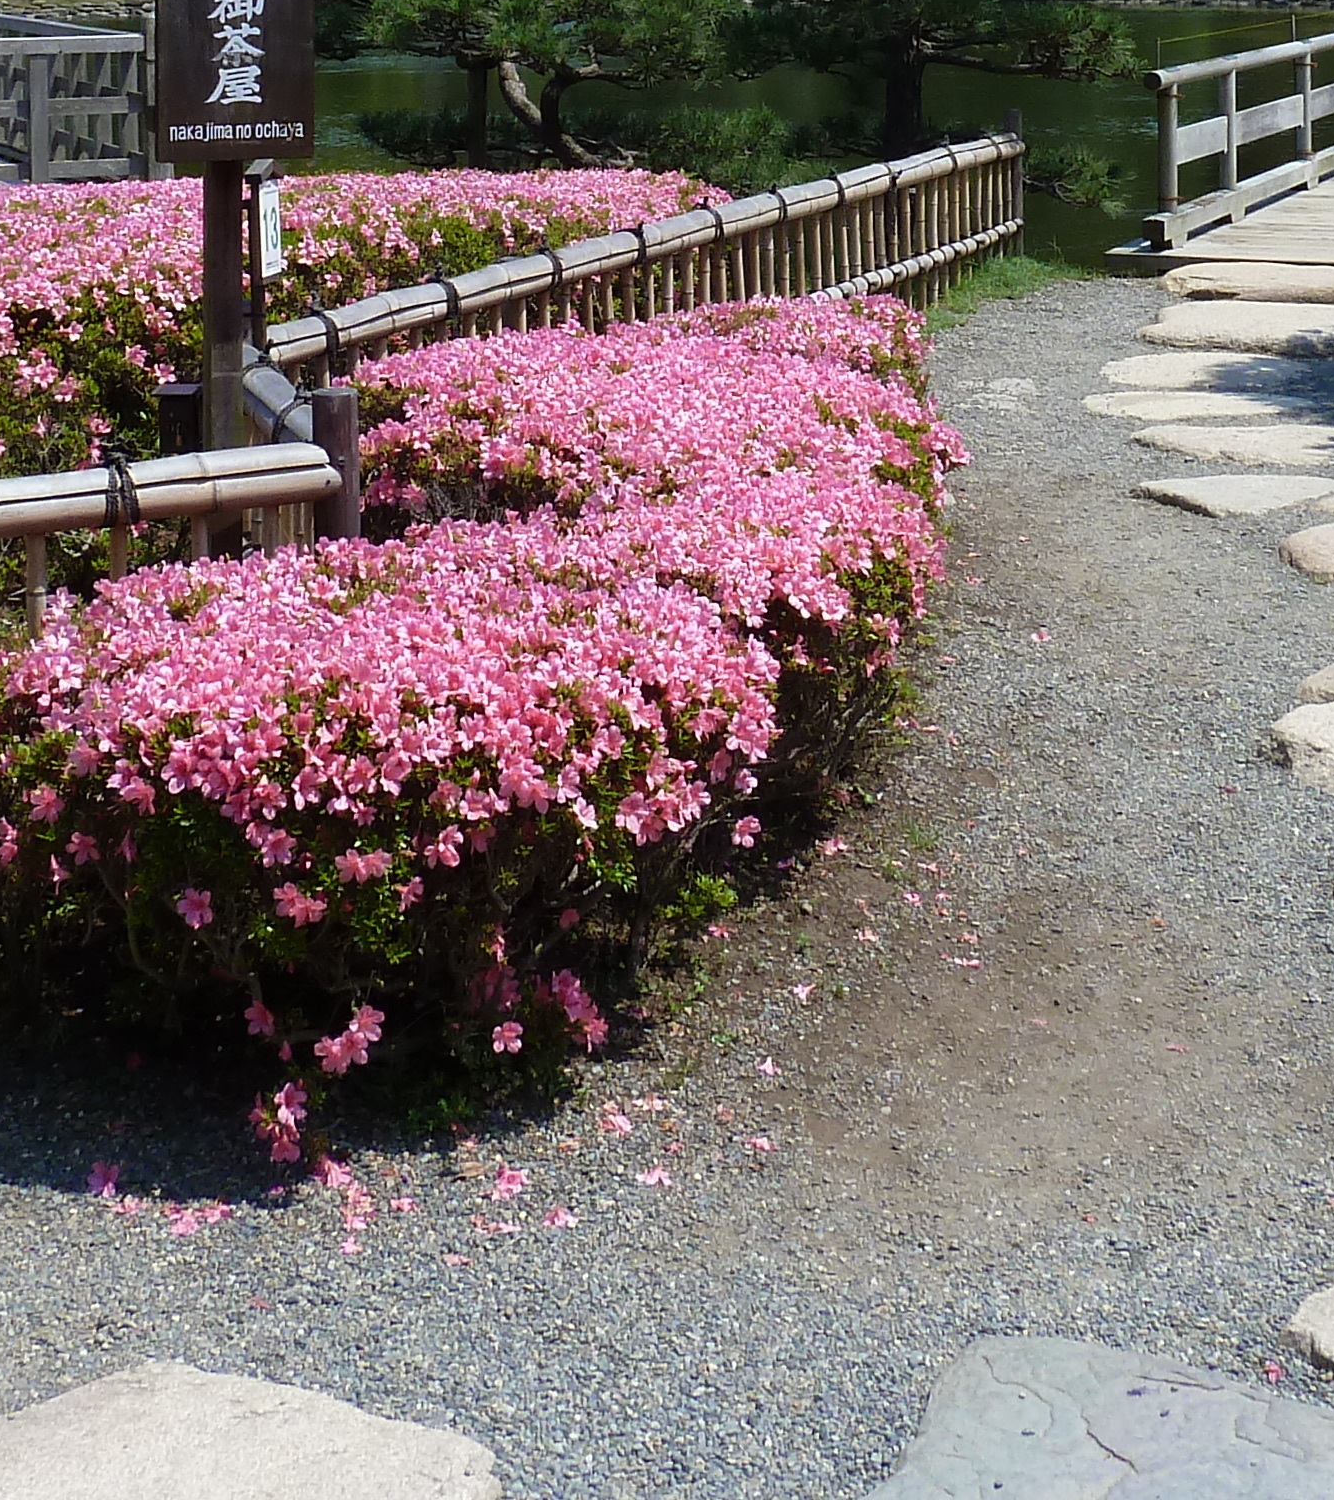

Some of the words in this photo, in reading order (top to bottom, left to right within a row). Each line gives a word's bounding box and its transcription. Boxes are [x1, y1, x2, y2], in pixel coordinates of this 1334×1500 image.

[235, 124, 252, 140] no
[254, 120, 304, 142] ochaya
[263, 206, 279, 252] 13
